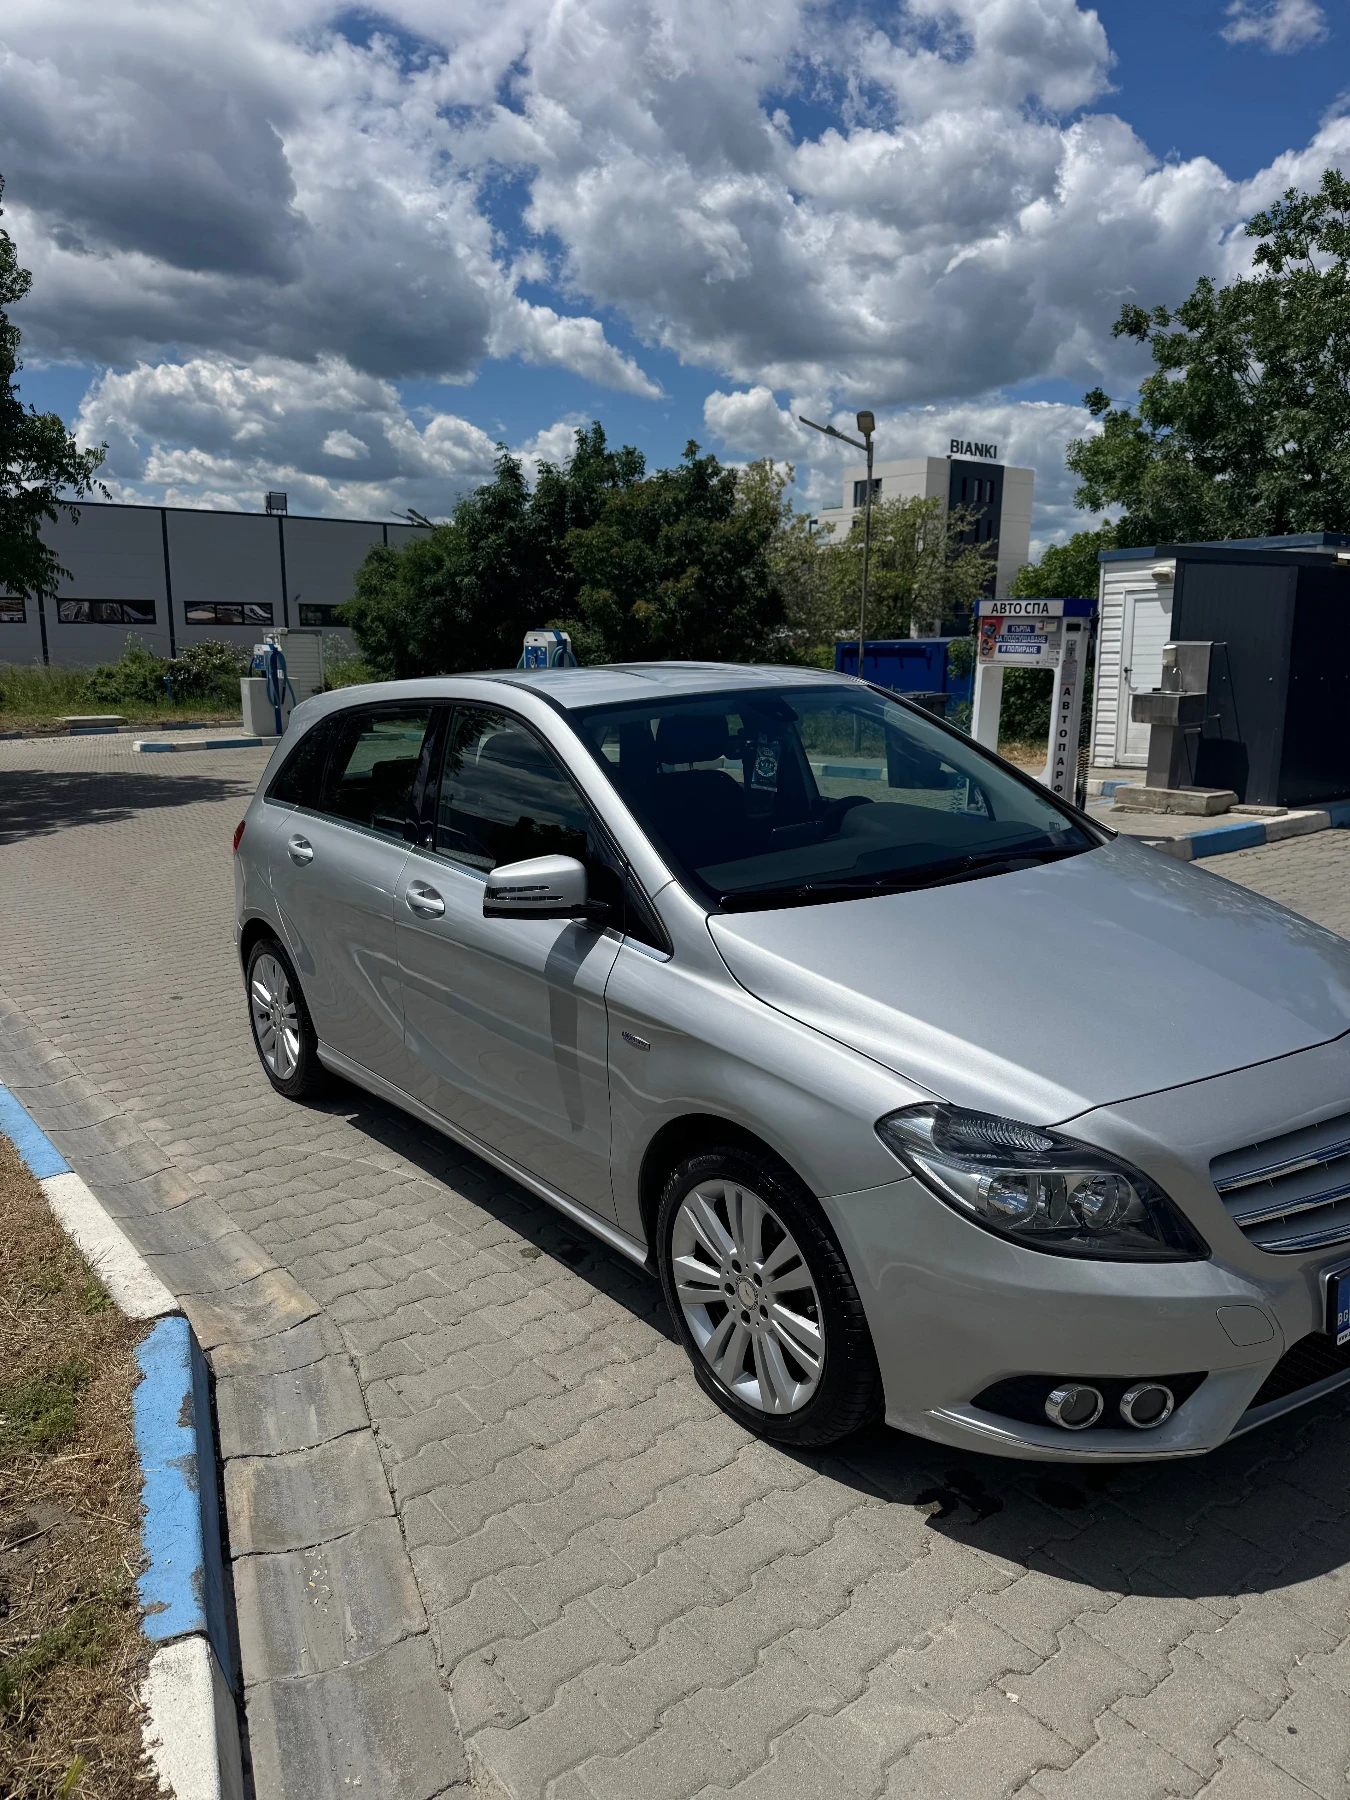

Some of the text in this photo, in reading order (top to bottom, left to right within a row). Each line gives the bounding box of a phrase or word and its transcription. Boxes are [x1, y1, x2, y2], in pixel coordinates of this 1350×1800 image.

[951, 439, 997, 459] BIANKI
[991, 603, 1049, 614] АВТО СПА
[1011, 625, 1031, 633] КЪРПА
[1338, 1309, 1349, 1326] BG
